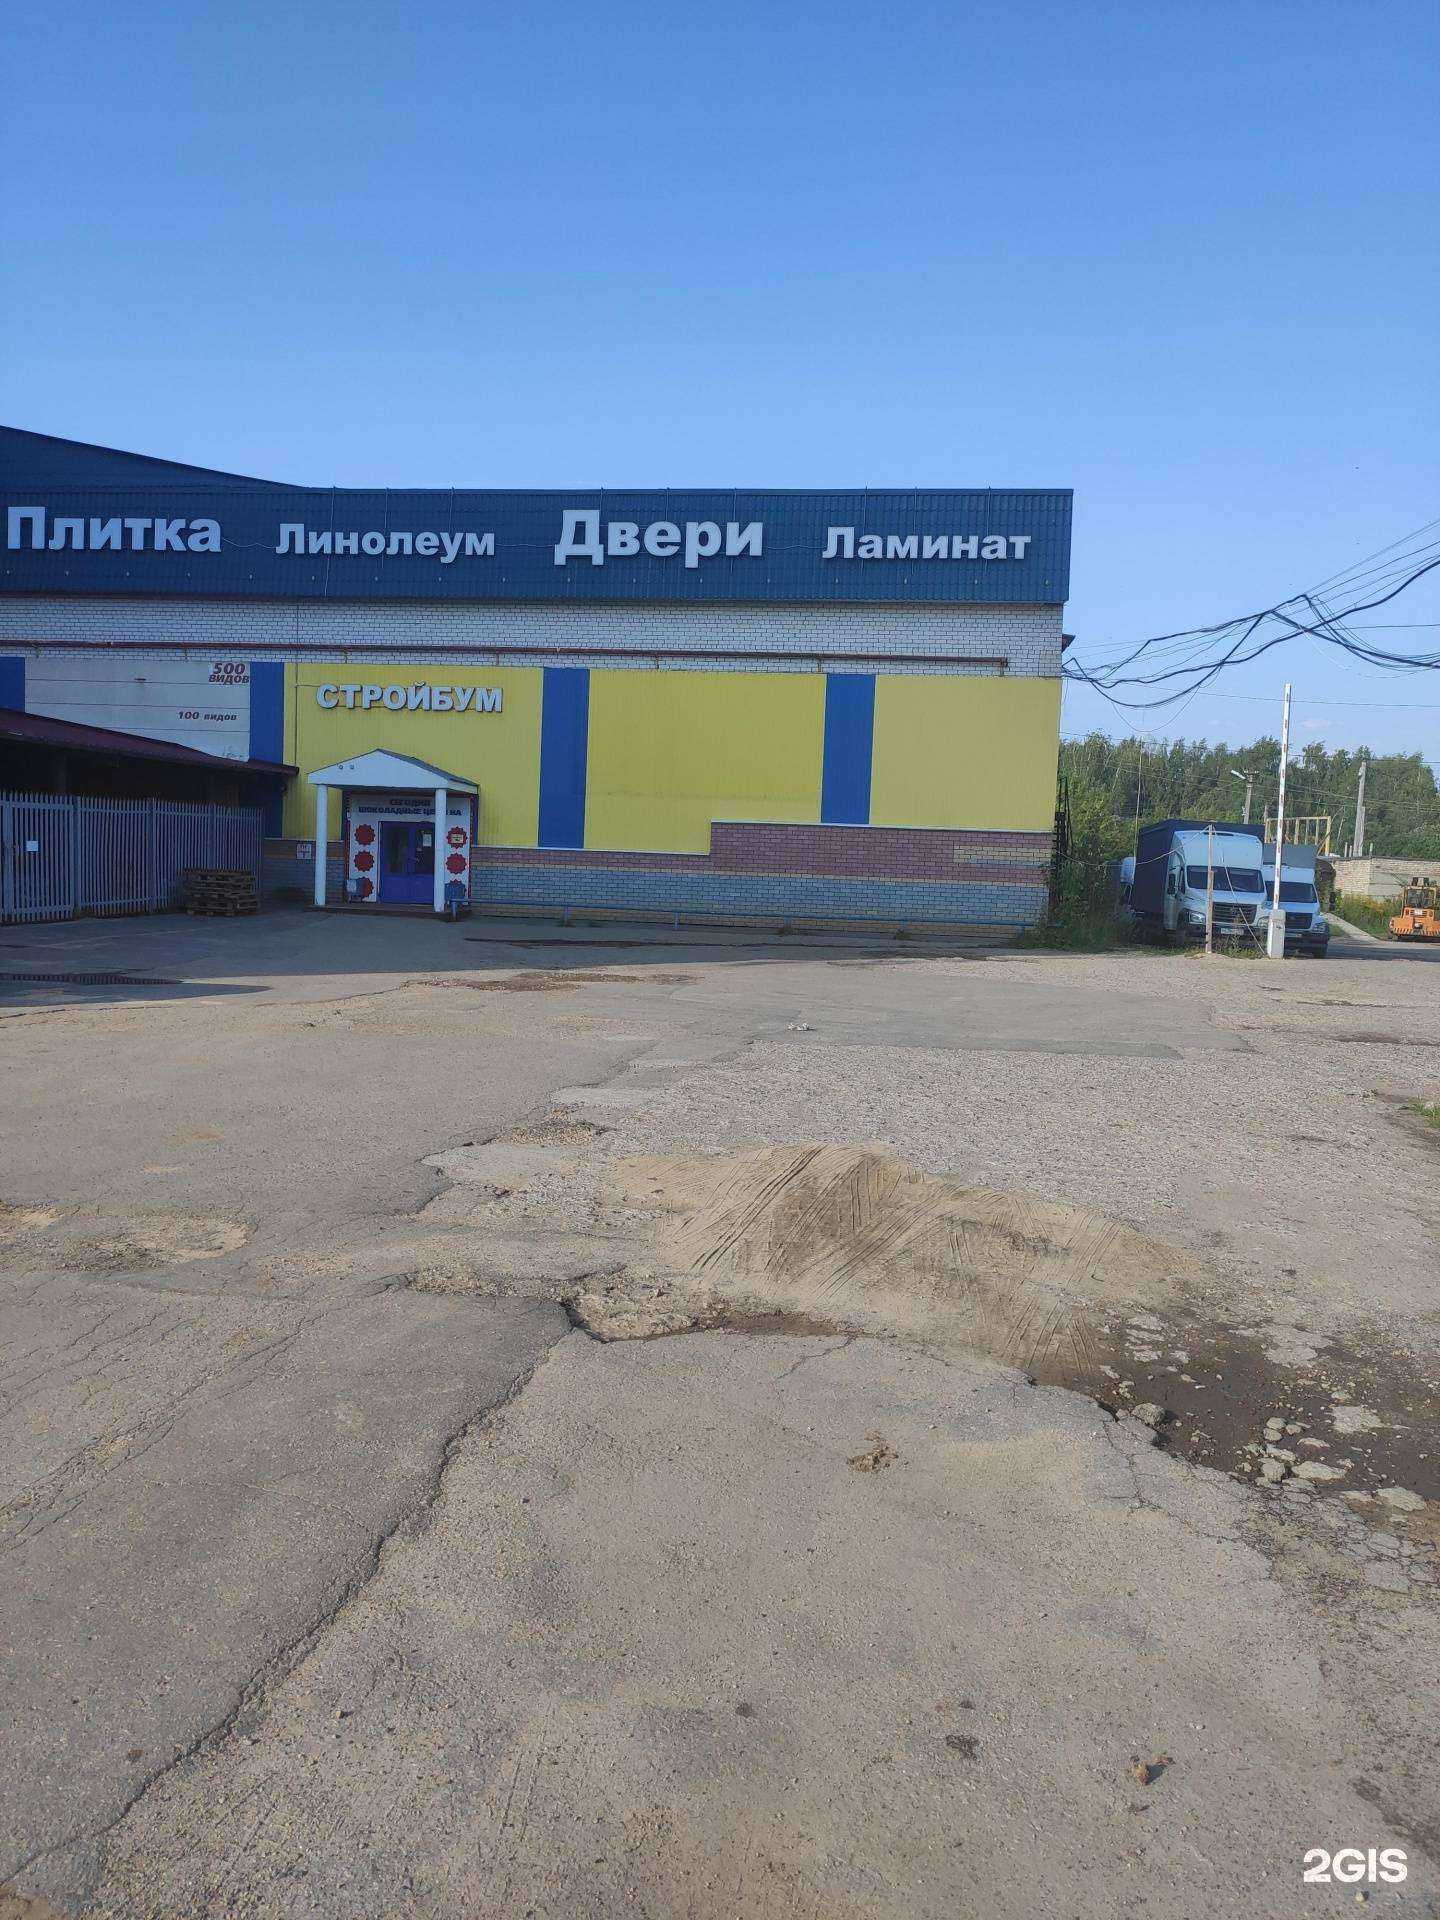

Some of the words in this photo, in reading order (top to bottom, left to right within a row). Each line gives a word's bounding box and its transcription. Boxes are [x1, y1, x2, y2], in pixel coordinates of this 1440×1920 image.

[7, 506, 222, 553] Плитка
[275, 523, 495, 564] Линолеум
[554, 509, 764, 568] Двери
[822, 526, 1032, 560] Ламинат
[213, 662, 246, 674] 500
[316, 681, 503, 713] СТРОЙБУМ
[178, 711, 199, 720] 100
